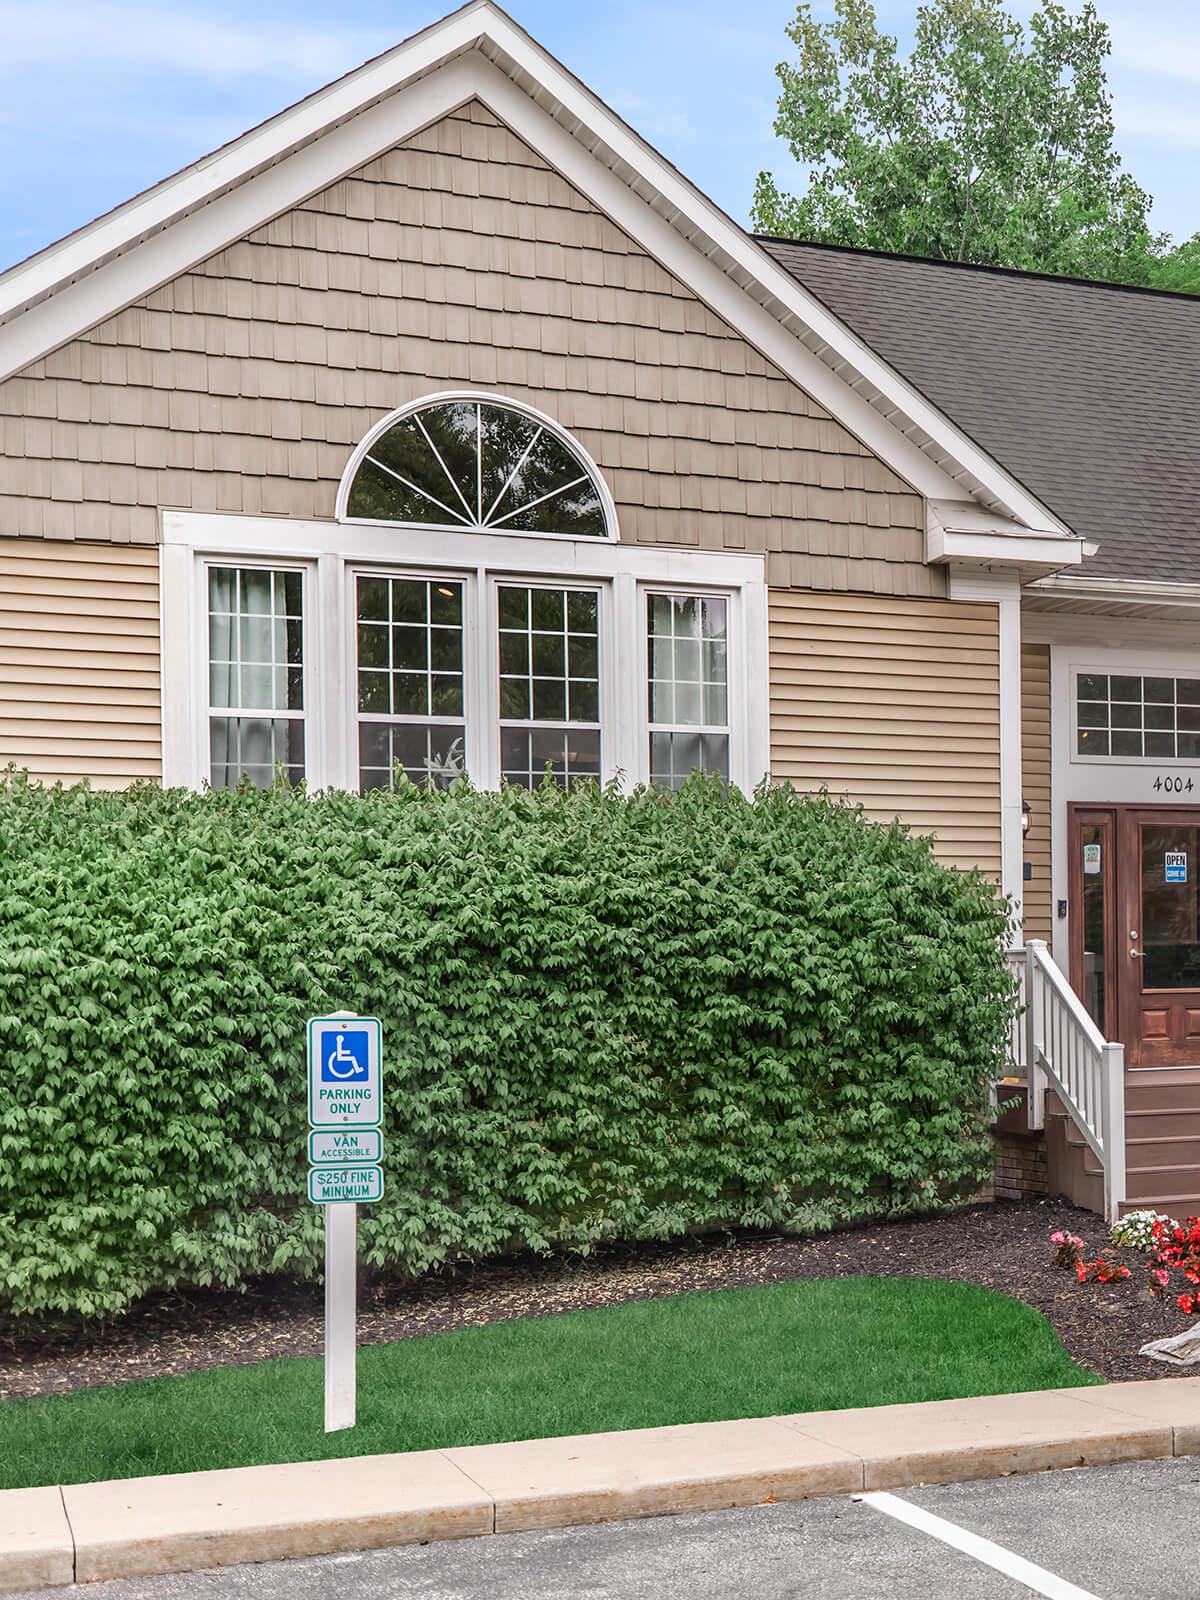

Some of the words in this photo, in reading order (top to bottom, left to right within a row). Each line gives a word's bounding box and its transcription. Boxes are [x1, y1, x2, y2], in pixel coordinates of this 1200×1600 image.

[1153, 776, 1194, 792] 4004
[1167, 855, 1185, 866] OPEN
[319, 1088, 372, 1100] PARKING
[330, 1103, 361, 1114] ONLY
[334, 1136, 359, 1147] VAN
[321, 1148, 371, 1157] ACCESSIBLE
[317, 1172, 348, 1184] $250
[351, 1171, 374, 1183] FINE
[322, 1185, 370, 1198] MINIMUM
